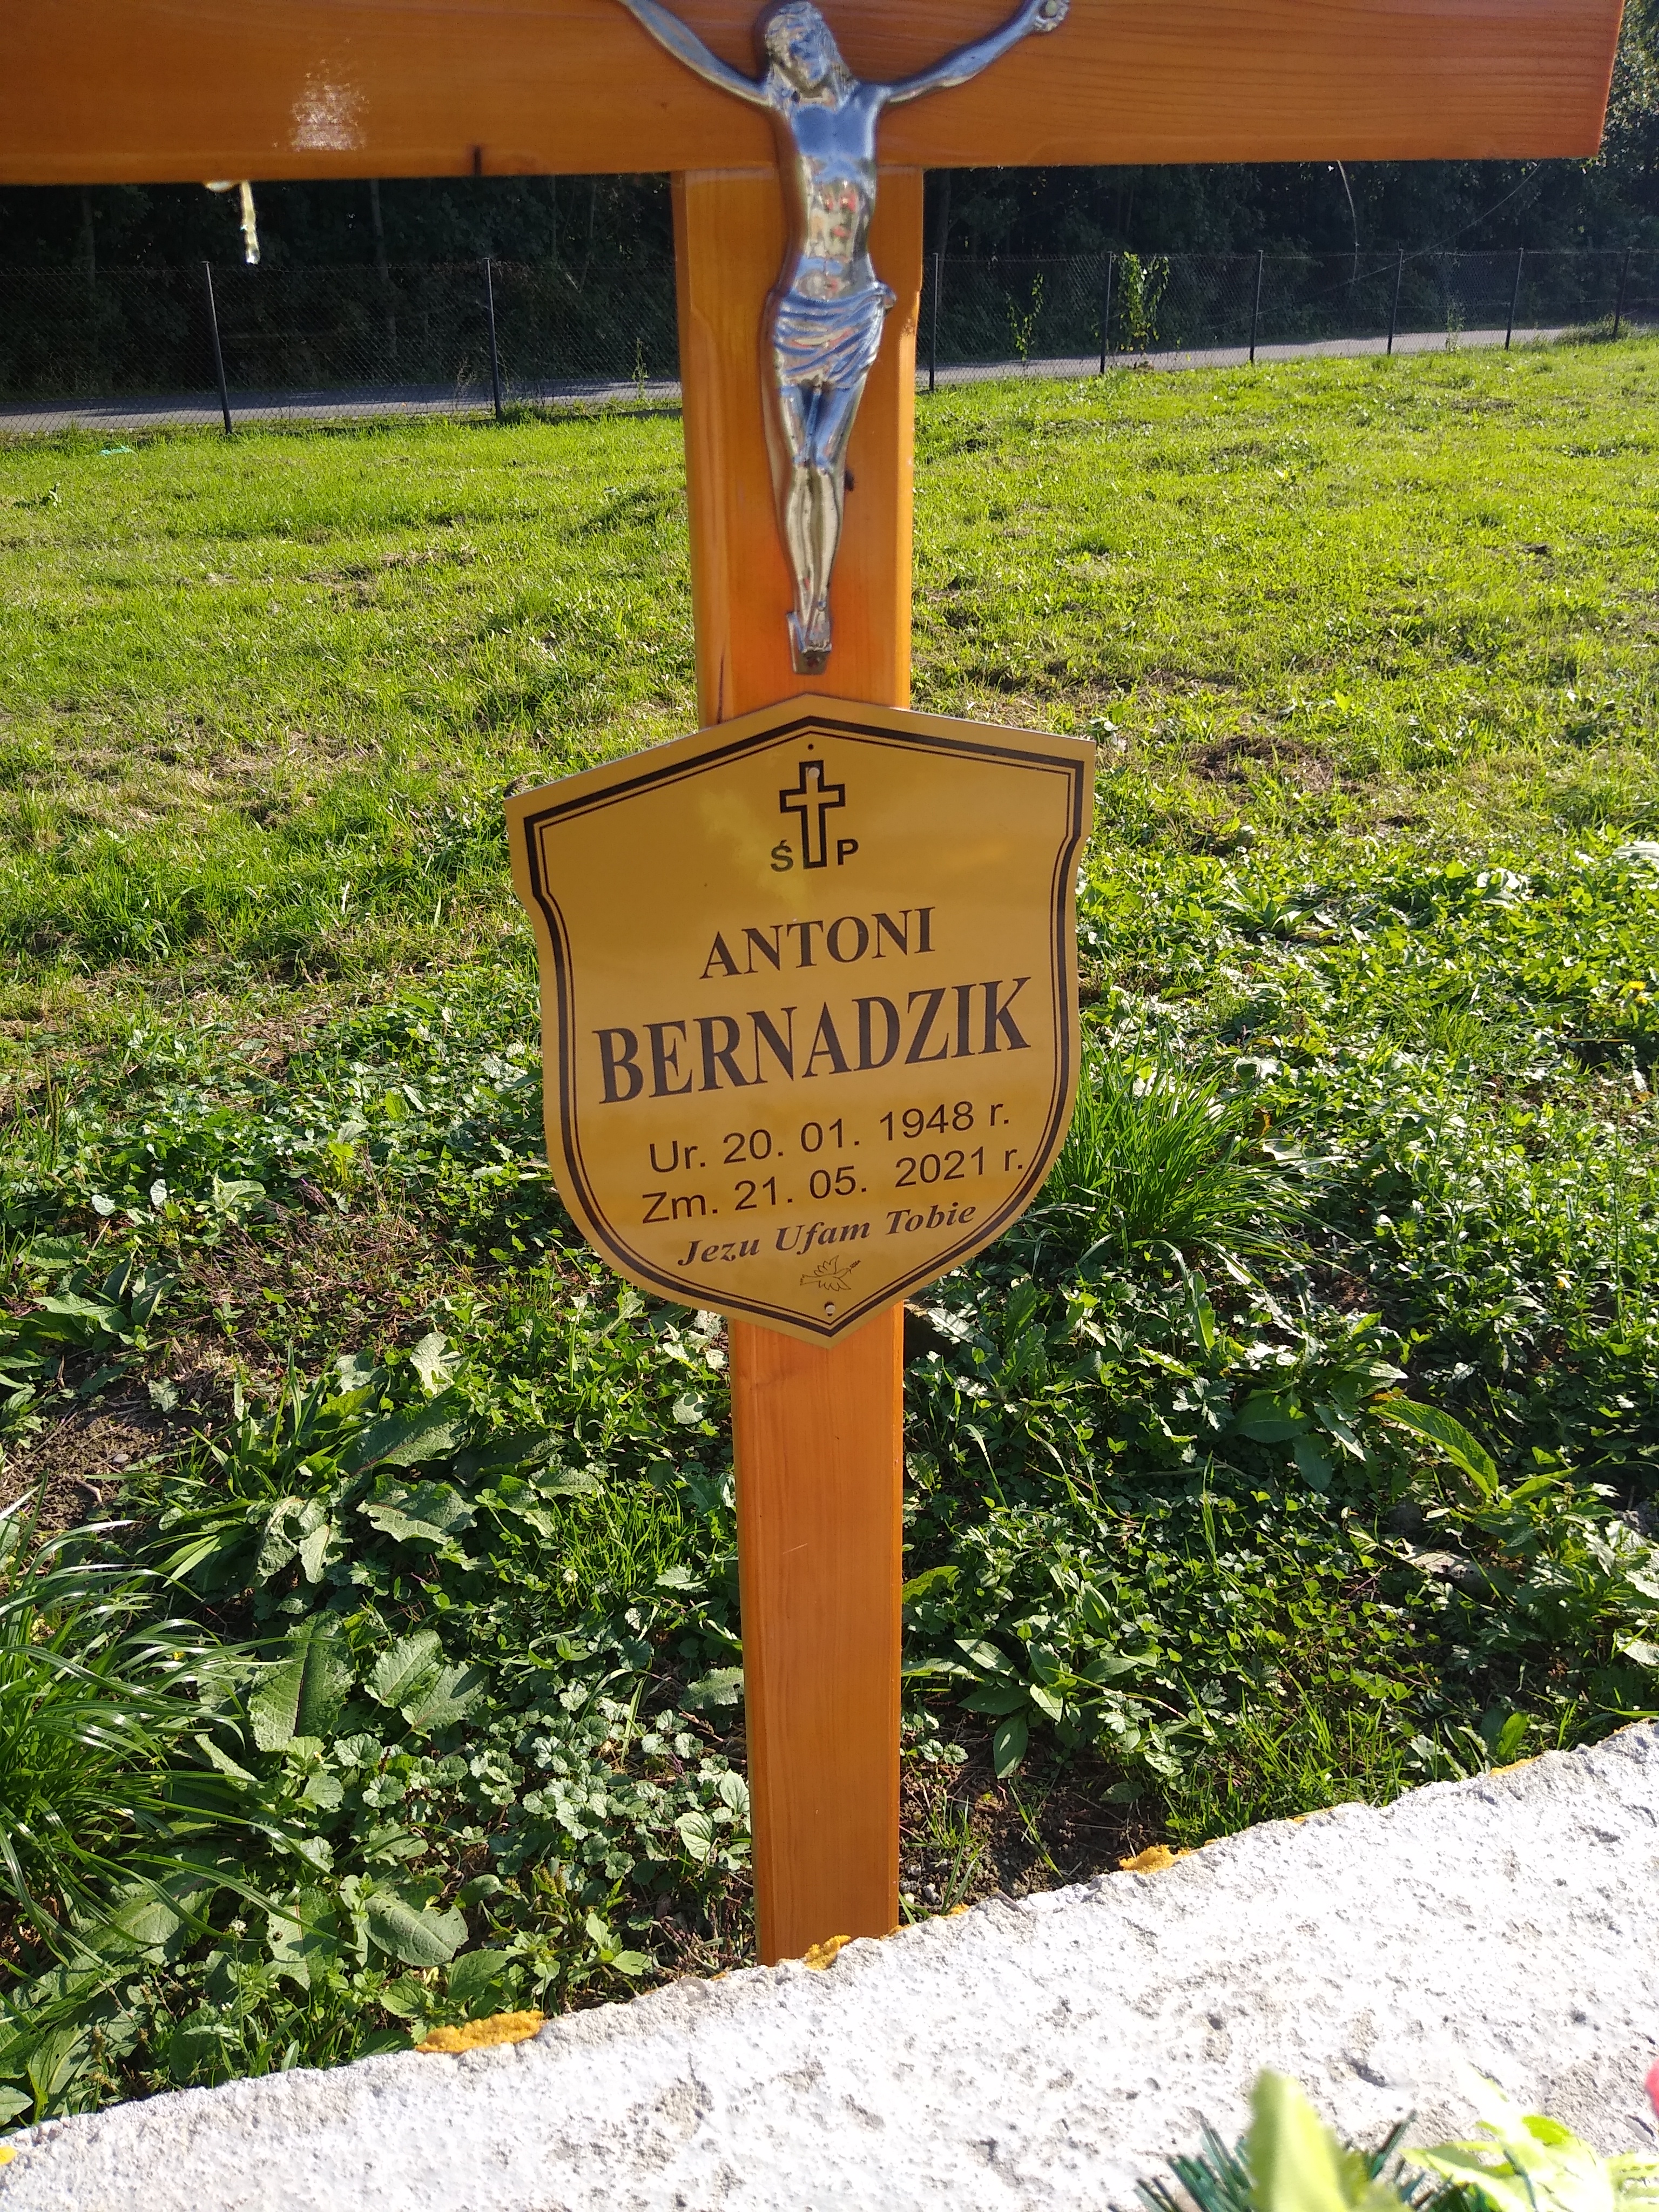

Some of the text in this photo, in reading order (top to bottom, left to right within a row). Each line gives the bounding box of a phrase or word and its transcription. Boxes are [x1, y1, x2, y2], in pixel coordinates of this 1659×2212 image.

[837, 839, 859, 866] P
[699, 906, 935, 980] ANTONI
[591, 976, 1031, 1104] BERNADZIK
[649, 1101, 1009, 1173] Ur. 20. 01. 1948 r.
[642, 1146, 1023, 1224] Zm. 21. 05. 2021 r.
[677, 1202, 976, 1266] Jezu Ufam Tobie
